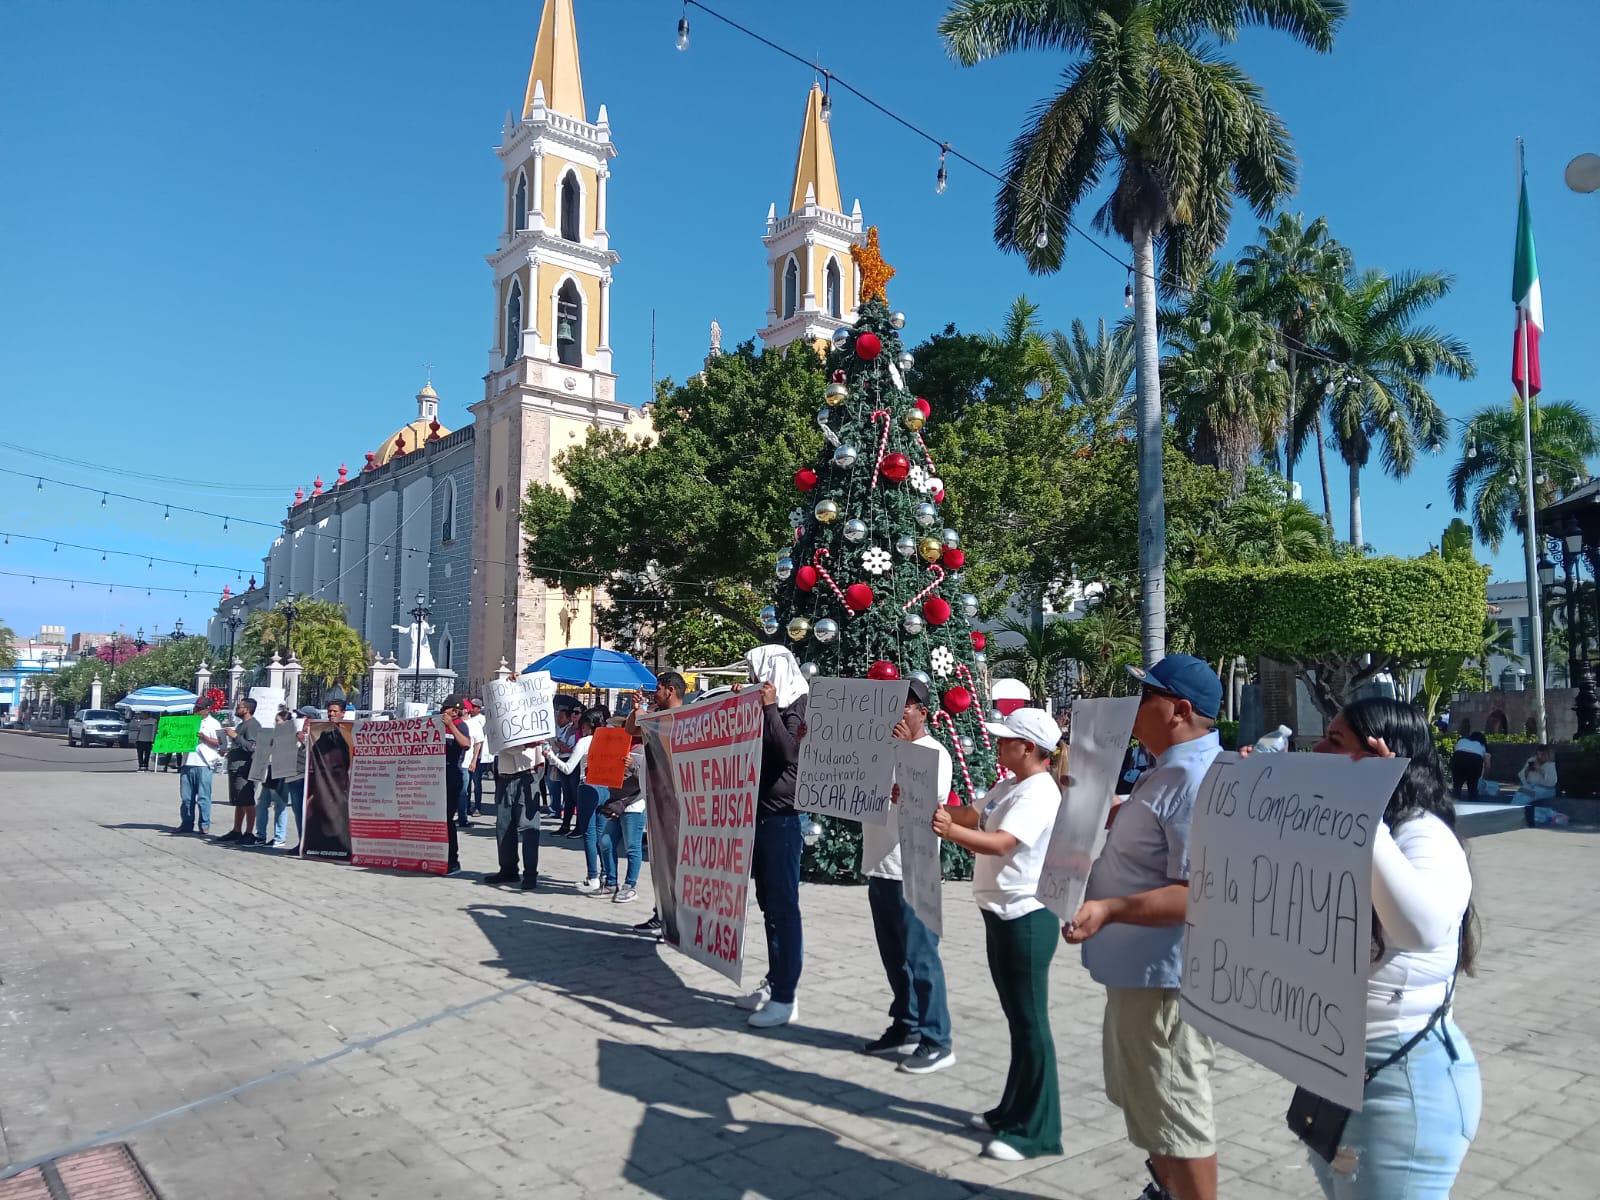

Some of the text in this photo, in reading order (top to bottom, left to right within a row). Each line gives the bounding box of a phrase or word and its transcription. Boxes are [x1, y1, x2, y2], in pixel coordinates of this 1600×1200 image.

[809, 681, 899, 717] Estrella
[355, 729, 442, 744] ENCONTRAR A
[360, 717, 435, 732] AYUDANOS A
[501, 709, 549, 740] OSCAR
[675, 700, 762, 746] DESAPARECIDO
[354, 746, 378, 756] OSCAR
[380, 745, 411, 756] AGUILAR
[803, 743, 878, 766] Ayudanos a
[679, 761, 697, 792] MI
[800, 767, 866, 783] encontrarlo
[685, 791, 754, 828] ME BUSCA
[797, 783, 847, 811] OSCAR
[849, 783, 889, 816] Aguilar
[1206, 761, 1370, 847] Tus Compañeros
[680, 834, 744, 875] AYUDAME
[1192, 847, 1358, 975] de la PLAYA
[694, 914, 704, 949] A
[1184, 921, 1346, 1057] Te Buscamos
